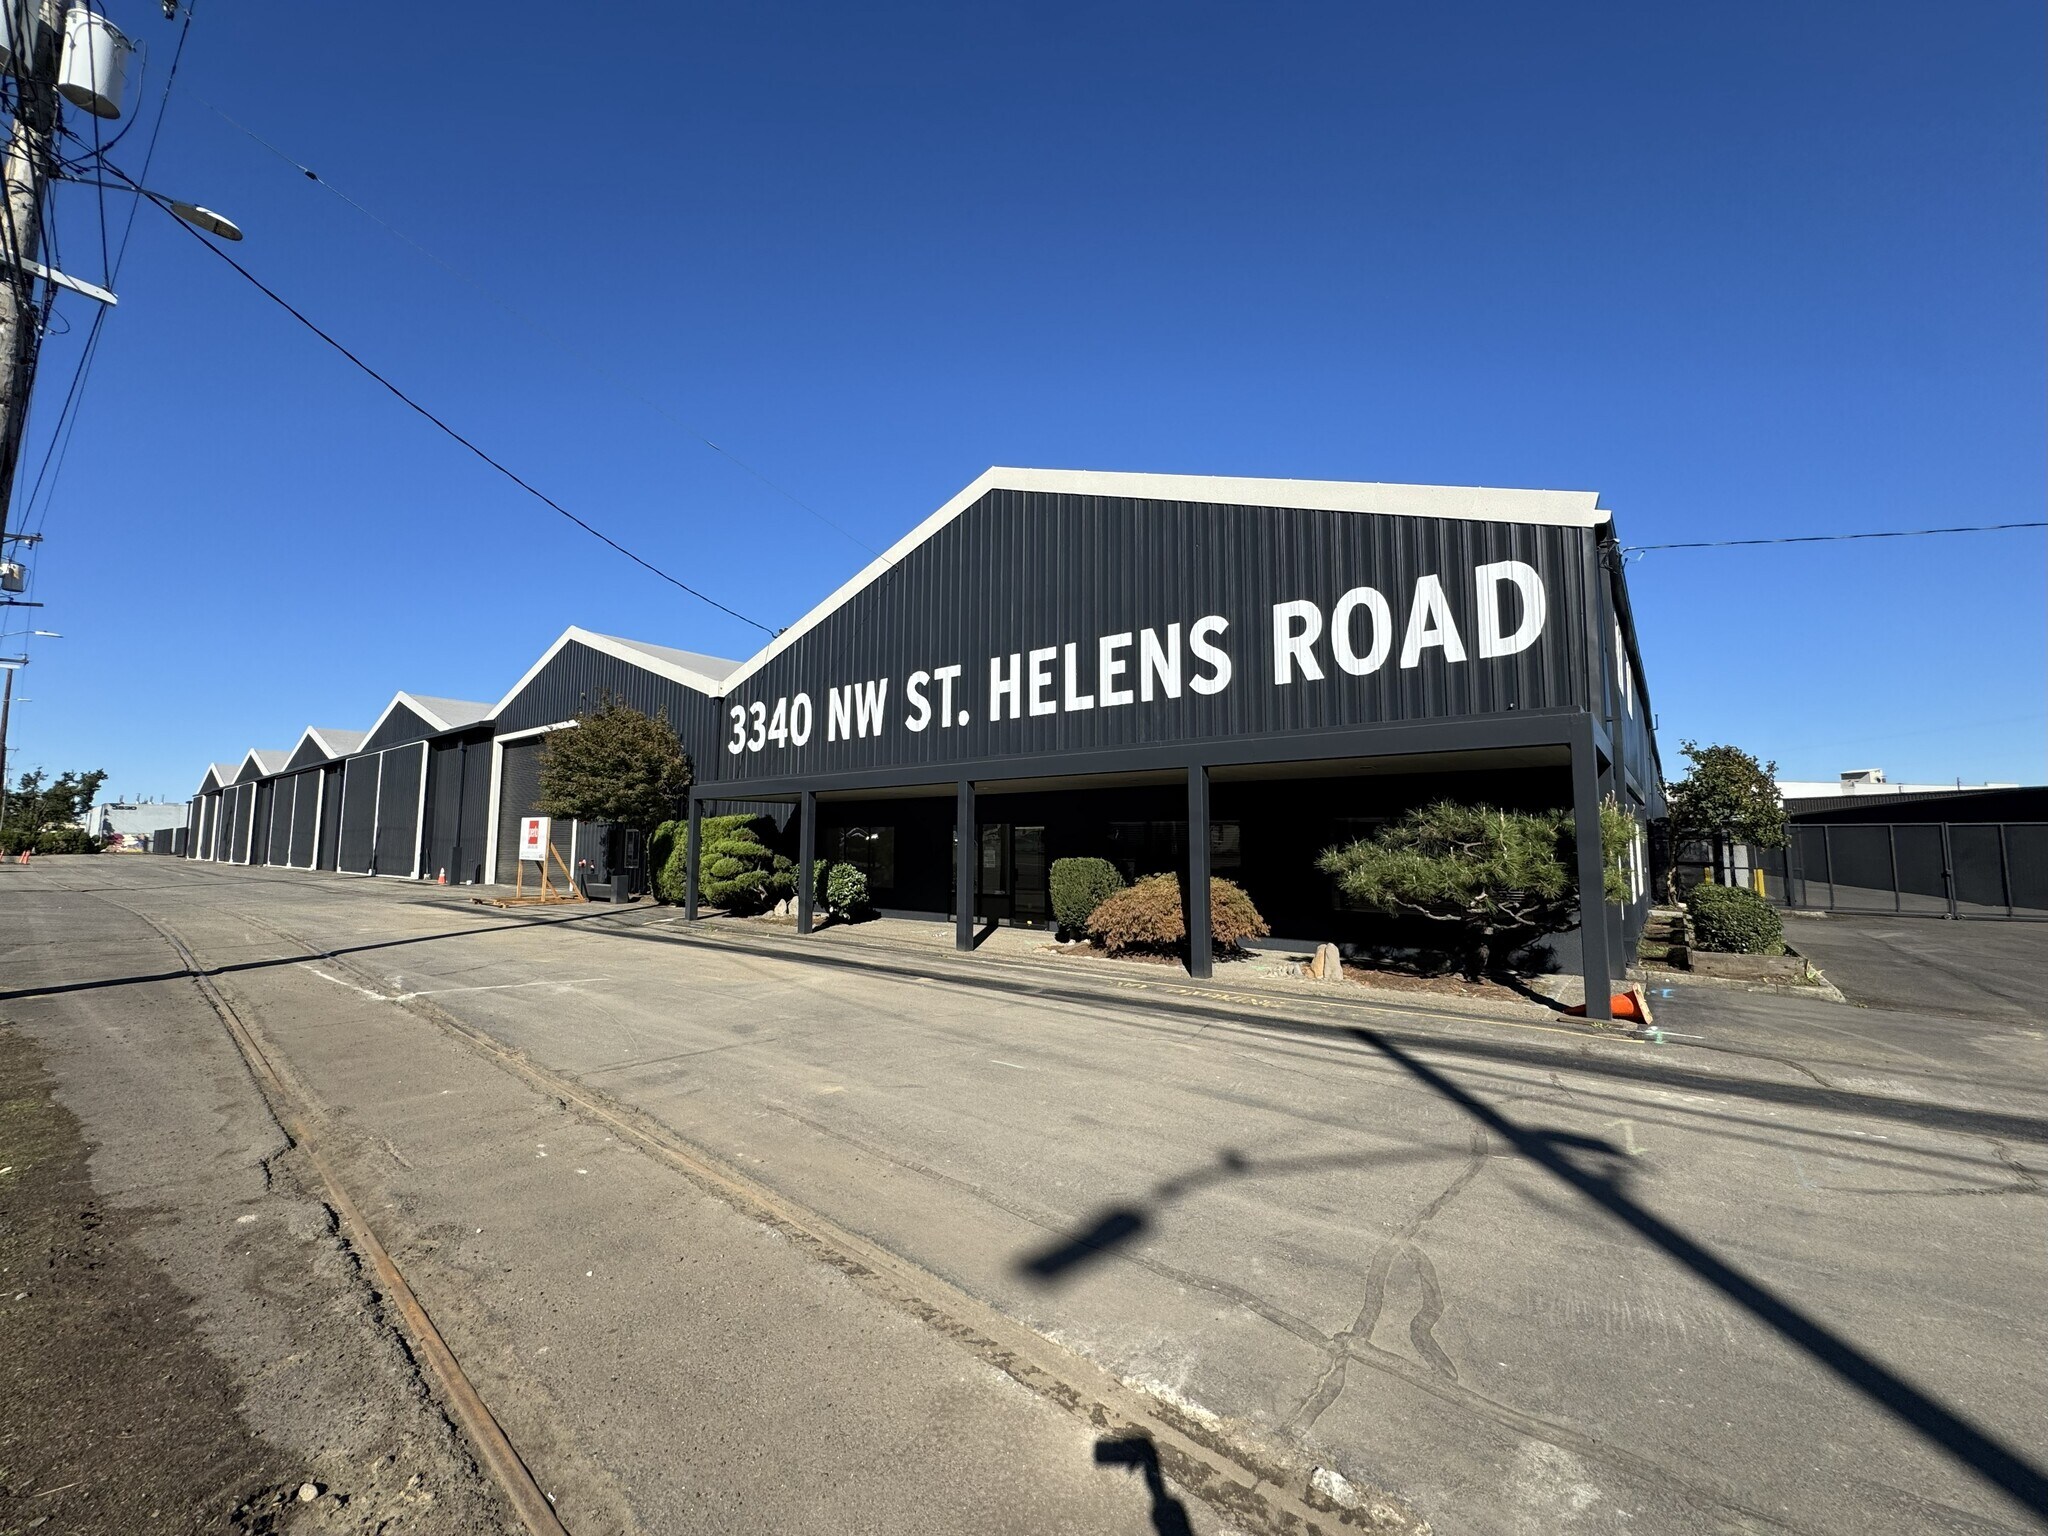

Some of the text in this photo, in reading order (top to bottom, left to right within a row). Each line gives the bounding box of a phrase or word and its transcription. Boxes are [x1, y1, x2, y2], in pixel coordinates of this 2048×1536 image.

[727, 559, 1548, 756] 3340 NW ST. HELENS ROAD
